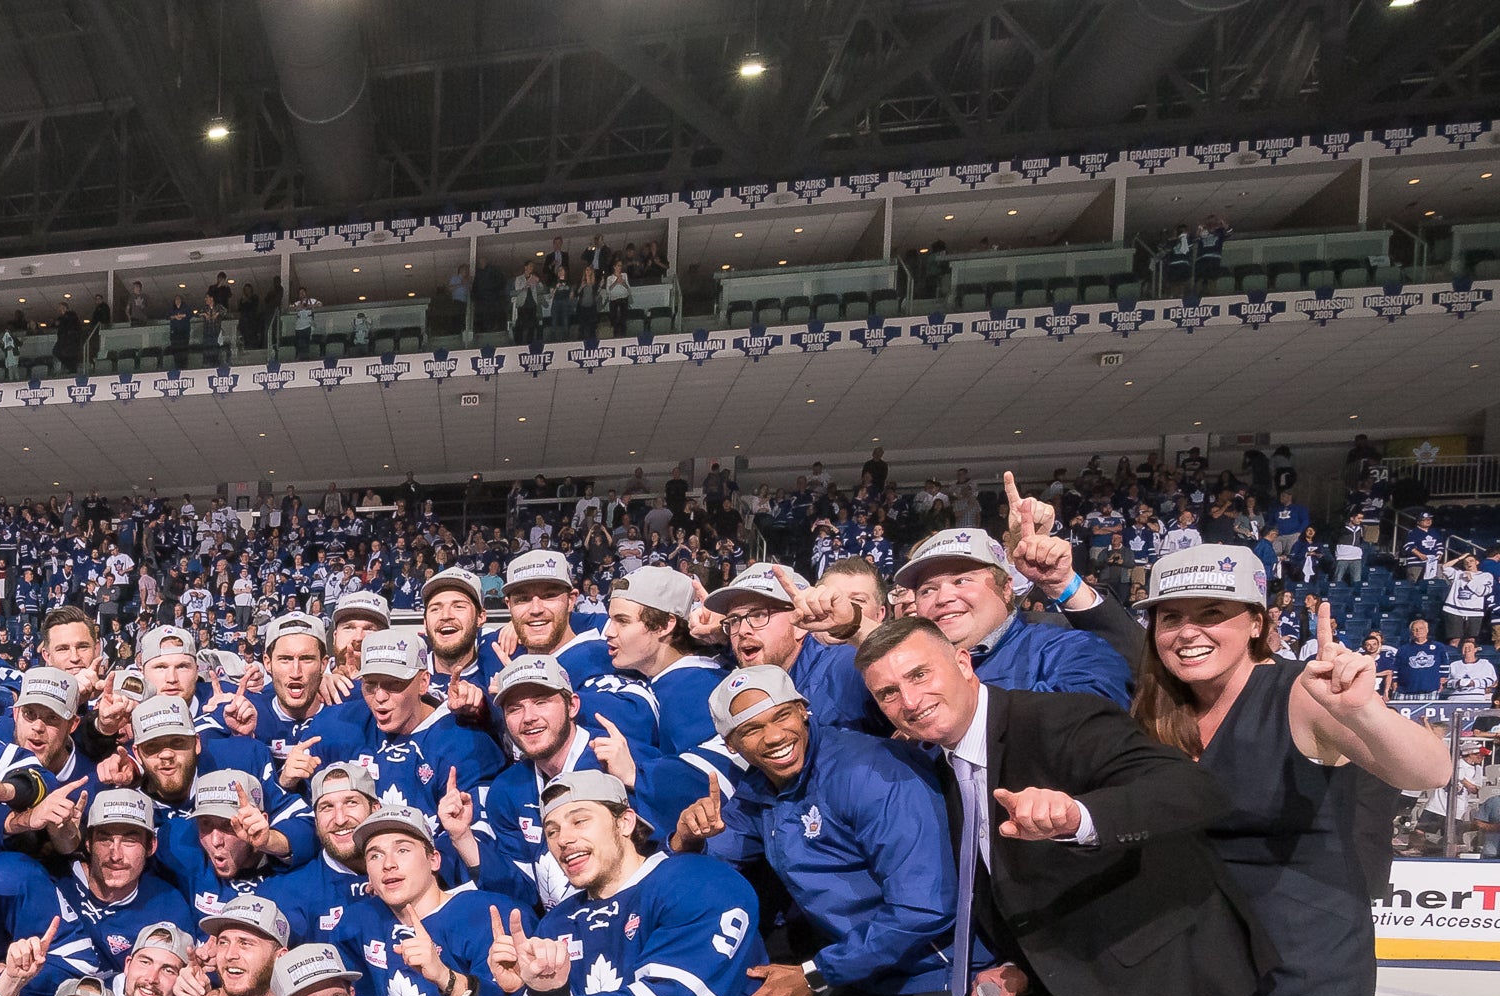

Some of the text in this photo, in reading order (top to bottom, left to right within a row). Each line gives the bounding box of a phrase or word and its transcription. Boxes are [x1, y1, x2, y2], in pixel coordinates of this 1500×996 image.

[1385, 128, 1414, 140] BROLL
[1445, 122, 1482, 135] DEVANE
[1256, 137, 1294, 150] D'AMIGO
[1323, 133, 1350, 145] LEIVO
[1130, 148, 1176, 161] GRANBERG
[1194, 143, 1231, 155] McKEGG
[1022, 158, 1050, 170] KOZUN
[1080, 153, 1108, 165] PERCY
[1204, 155, 1220, 163] 2014
[894, 168, 943, 181] MacWILLIAM
[956, 163, 993, 176] CARRICK
[794, 179, 826, 191] SPARKS
[849, 174, 879, 185] FROESE
[691, 190, 711, 200] LOOV
[739, 184, 768, 196] LEIPSIC
[585, 200, 613, 211] HYMAN
[630, 194, 669, 206] NYLANDER
[481, 209, 515, 221] KAPANEN
[526, 203, 567, 217] SOSHNIKOV
[391, 218, 417, 229] BROWN
[438, 214, 463, 225] VALIEV
[293, 227, 325, 239] LINDBERG
[338, 222, 372, 234] GAUTHIER
[252, 232, 277, 242] BIBEAU
[1365, 294, 1421, 307] ORESKOVIC
[1439, 291, 1485, 304] ROSEHILL
[1241, 302, 1273, 314] BOZAK
[1296, 298, 1354, 311] GUNNARSSON
[1452, 303, 1472, 312] 2009
[1111, 311, 1142, 323] POGGE
[1170, 306, 1213, 318] DEVEAUX
[1314, 310, 1333, 319] 2009
[1382, 306, 1401, 316] 2009
[1045, 315, 1077, 327] SIFERS
[1247, 314, 1266, 323] 2009
[920, 324, 953, 336] FOSTER
[976, 318, 1021, 332] MITCHELL
[802, 332, 830, 344] BOYCE
[865, 328, 886, 339] EARL
[678, 340, 723, 352] STRALMAN
[741, 336, 773, 348] TLUSTY
[571, 349, 613, 361] WILLIAMS
[626, 345, 665, 356] NEWBURY
[692, 351, 708, 360] 2007
[477, 358, 499, 368] BELL
[521, 354, 551, 365] WHITE
[1102, 354, 1120, 366] 101
[368, 363, 409, 375] HARRISON
[426, 360, 456, 372] ONDRUS
[254, 371, 294, 383] GOVEDARIS
[310, 368, 351, 379] KRONWALL
[111, 383, 139, 393] CIMETTA
[154, 379, 192, 390] JOHNSTON
[212, 377, 233, 387] BERG
[17, 389, 53, 398] ARMSTRONG
[70, 386, 93, 396] ZEZEL
[168, 389, 180, 397] 1991
[462, 396, 478, 405] 100
[514, 567, 557, 580] CHAMPIONS
[1172, 566, 1198, 576] CALDER
[1160, 572, 1235, 590] CHAMPIONS
[366, 649, 407, 662] CHAMPIONS
[104, 807, 145, 819] CHAMPIONS
[712, 907, 749, 960] 9
[297, 957, 315, 968] CALDER
